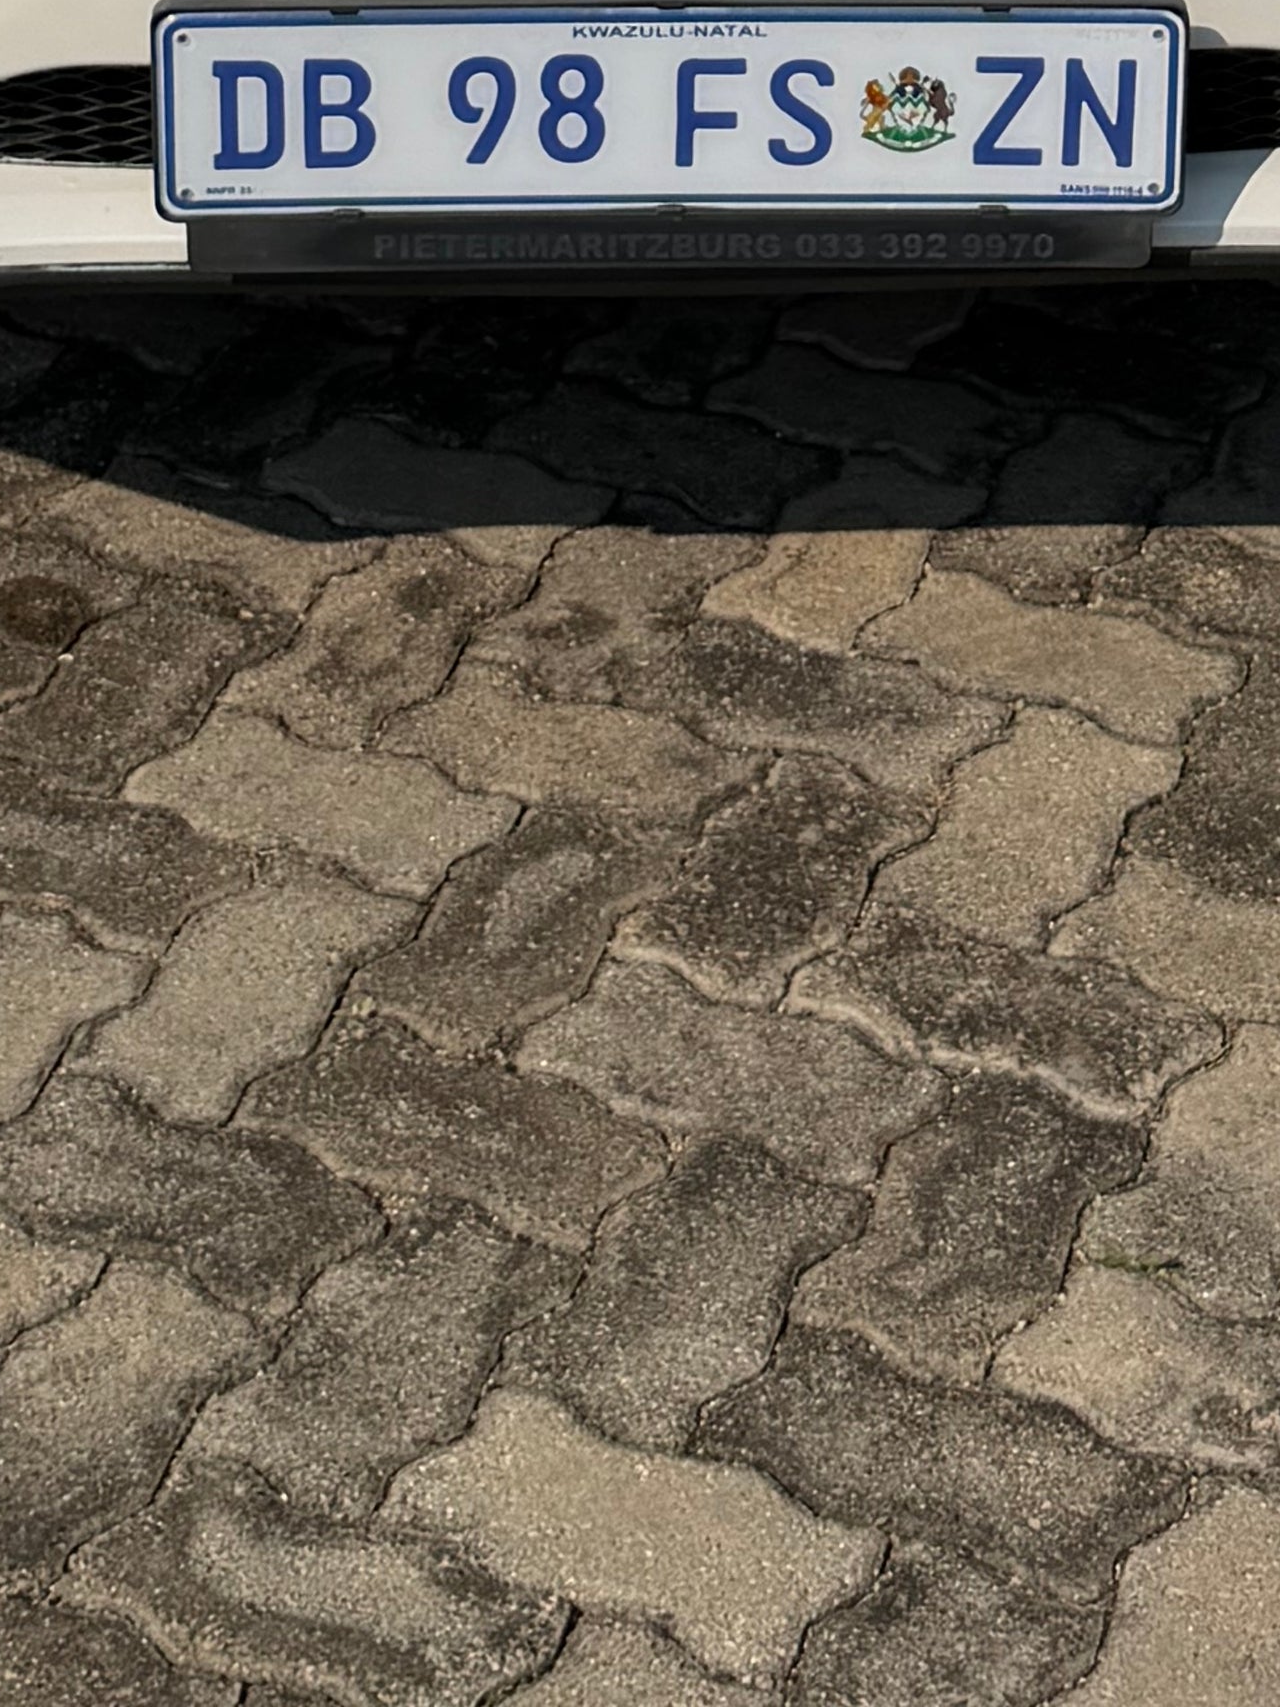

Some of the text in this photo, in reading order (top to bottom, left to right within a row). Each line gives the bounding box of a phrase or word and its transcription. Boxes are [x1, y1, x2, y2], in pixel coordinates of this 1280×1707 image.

[572, 24, 768, 38] KWAZULU-NATAL
[213, 53, 1137, 170] DB 98 FS ZN
[373, 232, 1055, 260] PIETERMARITZBURG 033 392 9970
